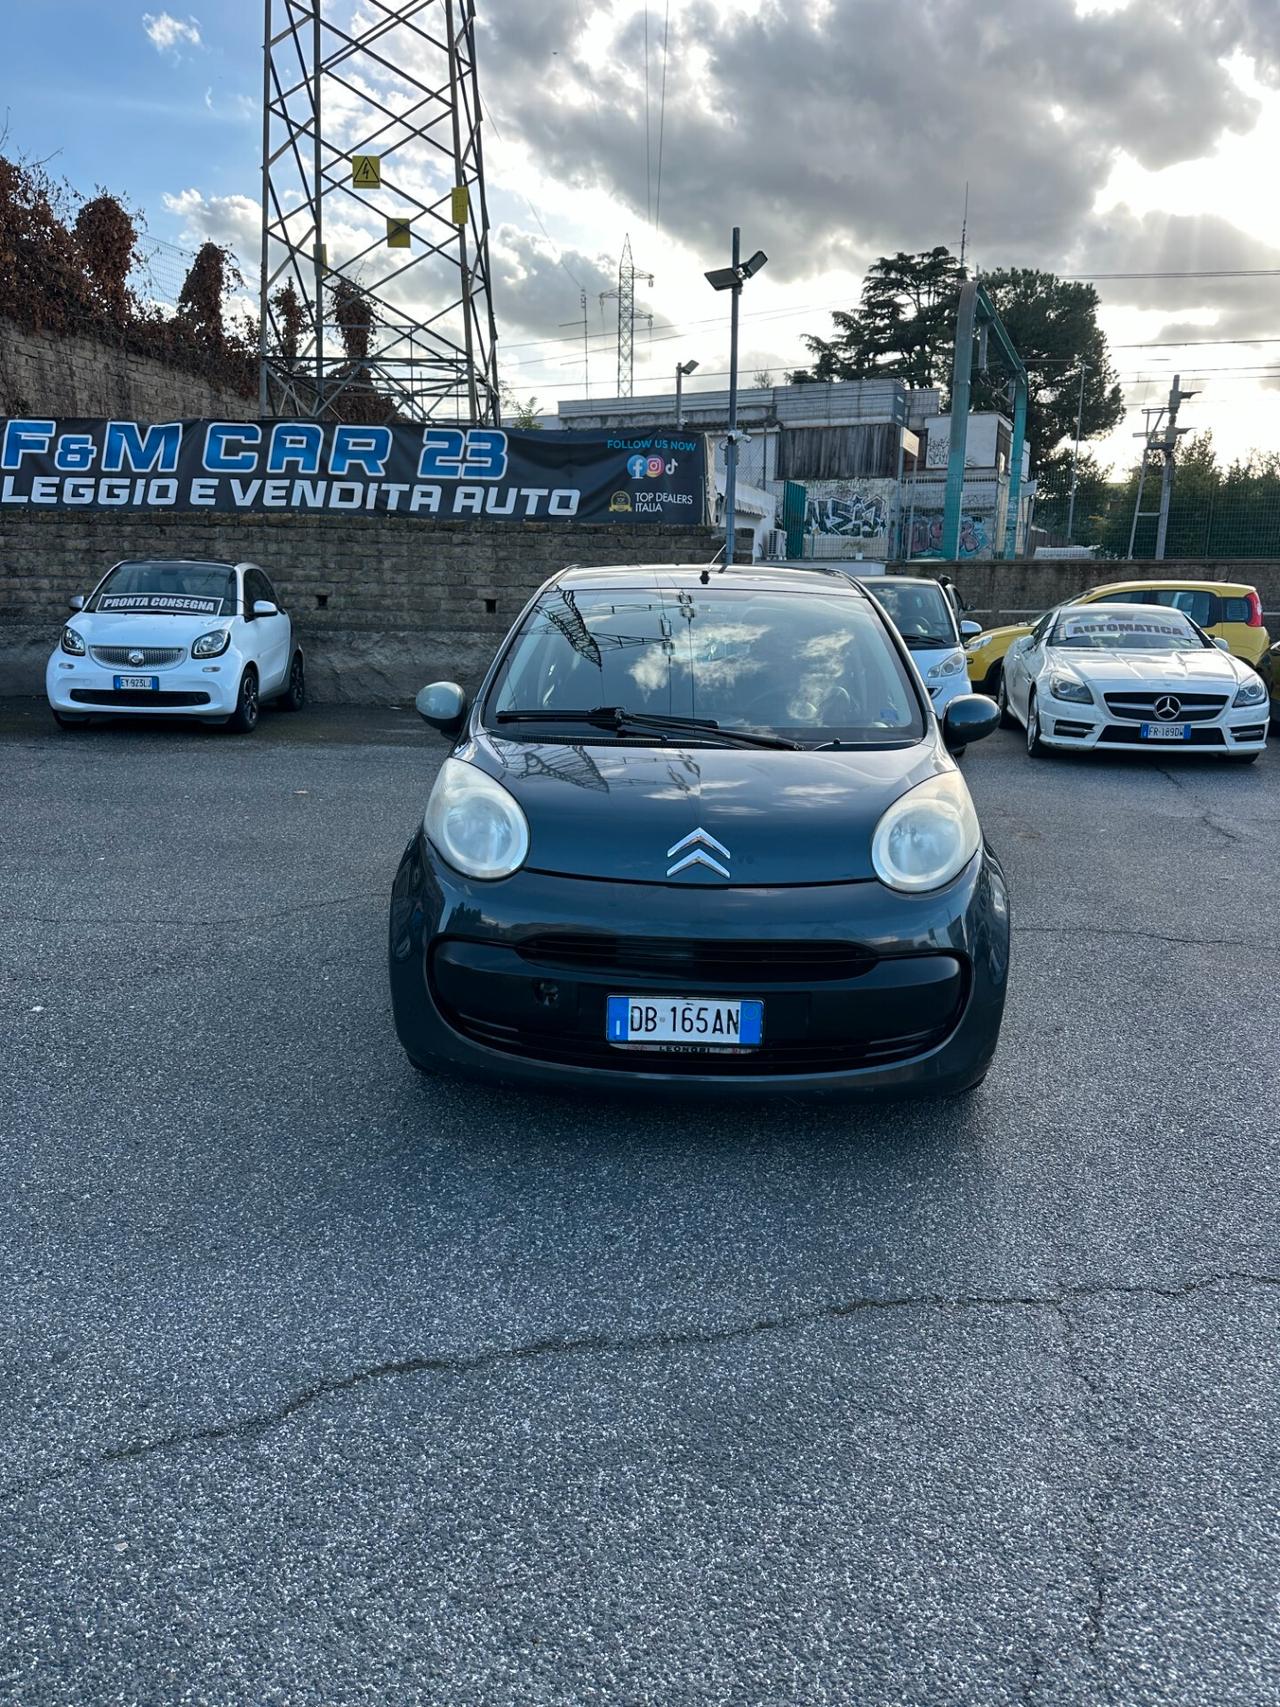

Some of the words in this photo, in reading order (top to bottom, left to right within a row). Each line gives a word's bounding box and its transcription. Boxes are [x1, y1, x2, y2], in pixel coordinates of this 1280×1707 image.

[1, 419, 183, 472] F&M
[202, 422, 393, 477] CAR
[417, 428, 508, 481] 23
[607, 439, 652, 449] FOLLOW
[655, 439, 668, 449] US
[670, 441, 697, 451] NOW
[1, 476, 179, 506] LEGGIO
[189, 479, 218, 506] E
[230, 479, 442, 512] VENDITA
[452, 487, 581, 516] AUTO
[635, 492, 654, 502] TOP
[656, 493, 693, 505] DEALERS
[635, 503, 663, 512] ITALIA
[103, 597, 149, 608] PRONTA
[150, 597, 215, 612] CONSEGNA
[1072, 623, 1184, 636] AUTOMATICA
